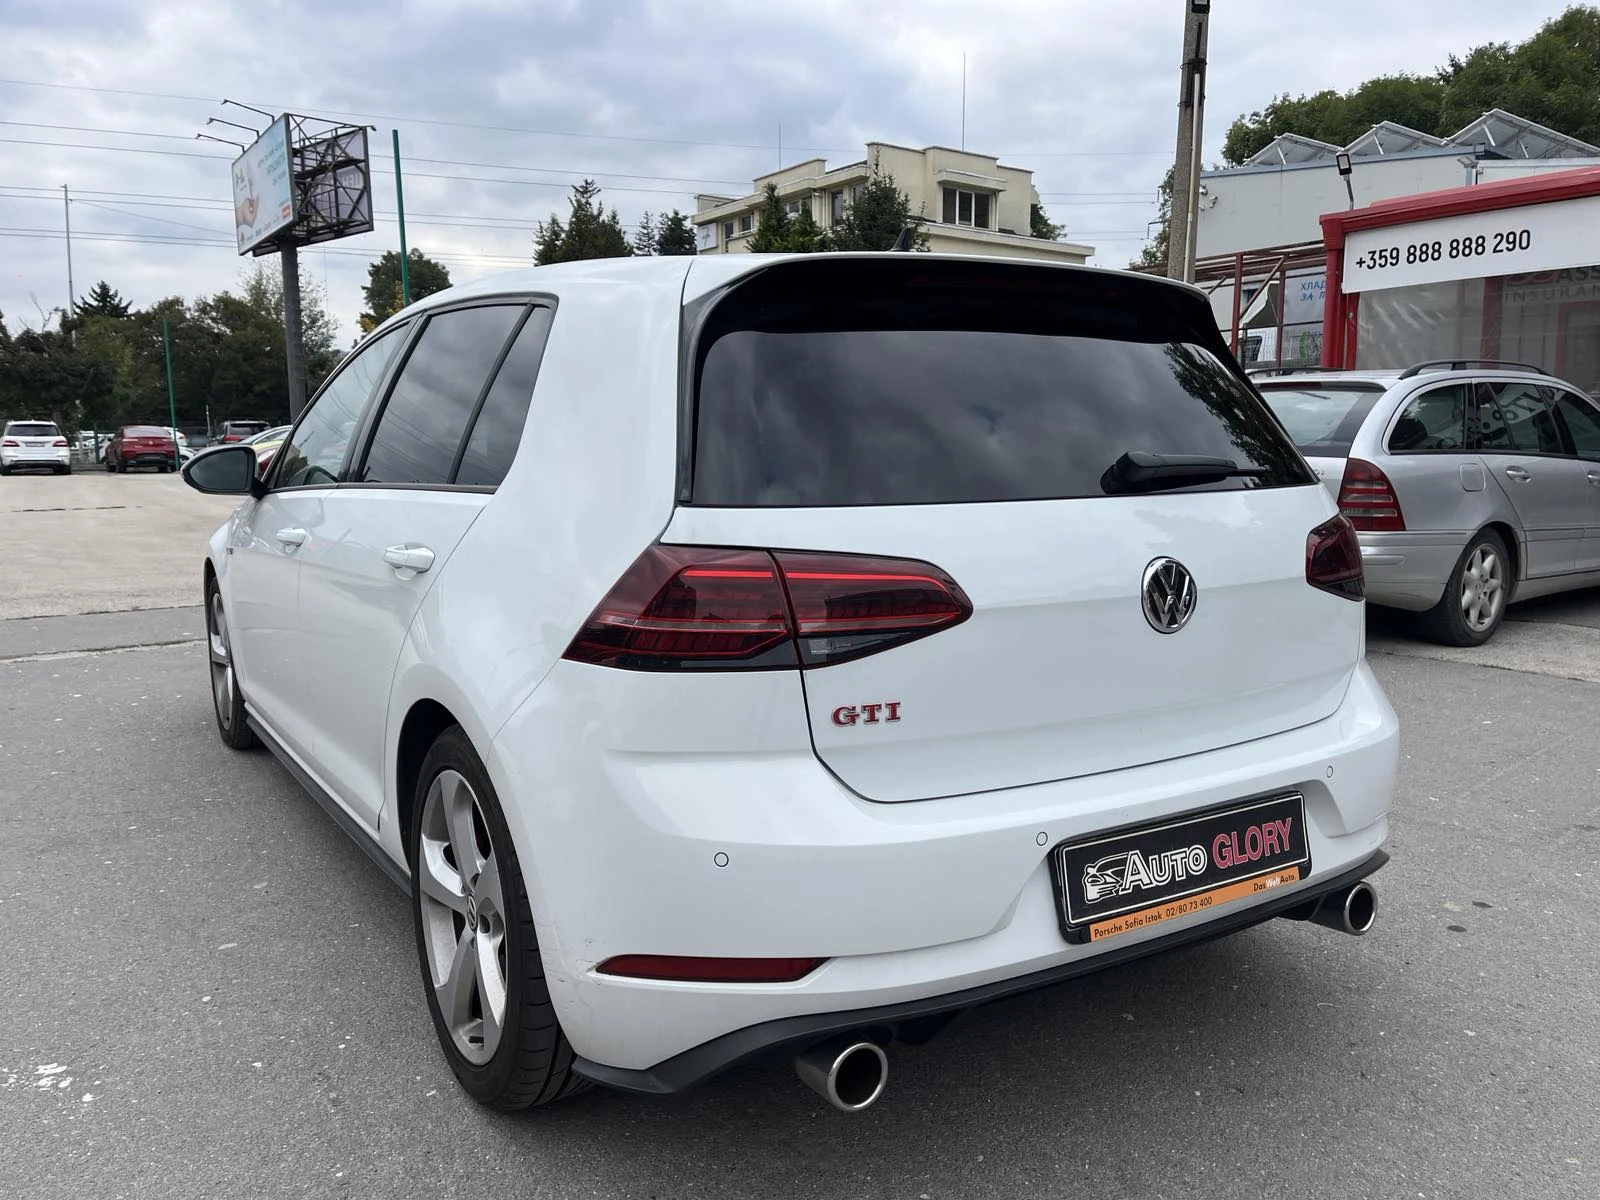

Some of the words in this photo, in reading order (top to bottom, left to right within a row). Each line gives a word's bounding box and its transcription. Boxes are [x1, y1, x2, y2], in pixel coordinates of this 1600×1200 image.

[1356, 247, 1400, 270] +359
[1406, 241, 1442, 264] 888
[1449, 235, 1486, 259] 888
[1492, 229, 1531, 254] 290
[831, 700, 901, 728] GTI
[1118, 844, 1208, 895] AUTO
[1212, 817, 1293, 869] GLORY
[1094, 923, 1123, 938] Porsche
[1124, 917, 1143, 930] Sofia
[1145, 911, 1163, 924] Iztok
[1165, 903, 1188, 918] 02/80
[1189, 901, 1198, 911] 73
[1199, 896, 1213, 907] 400
